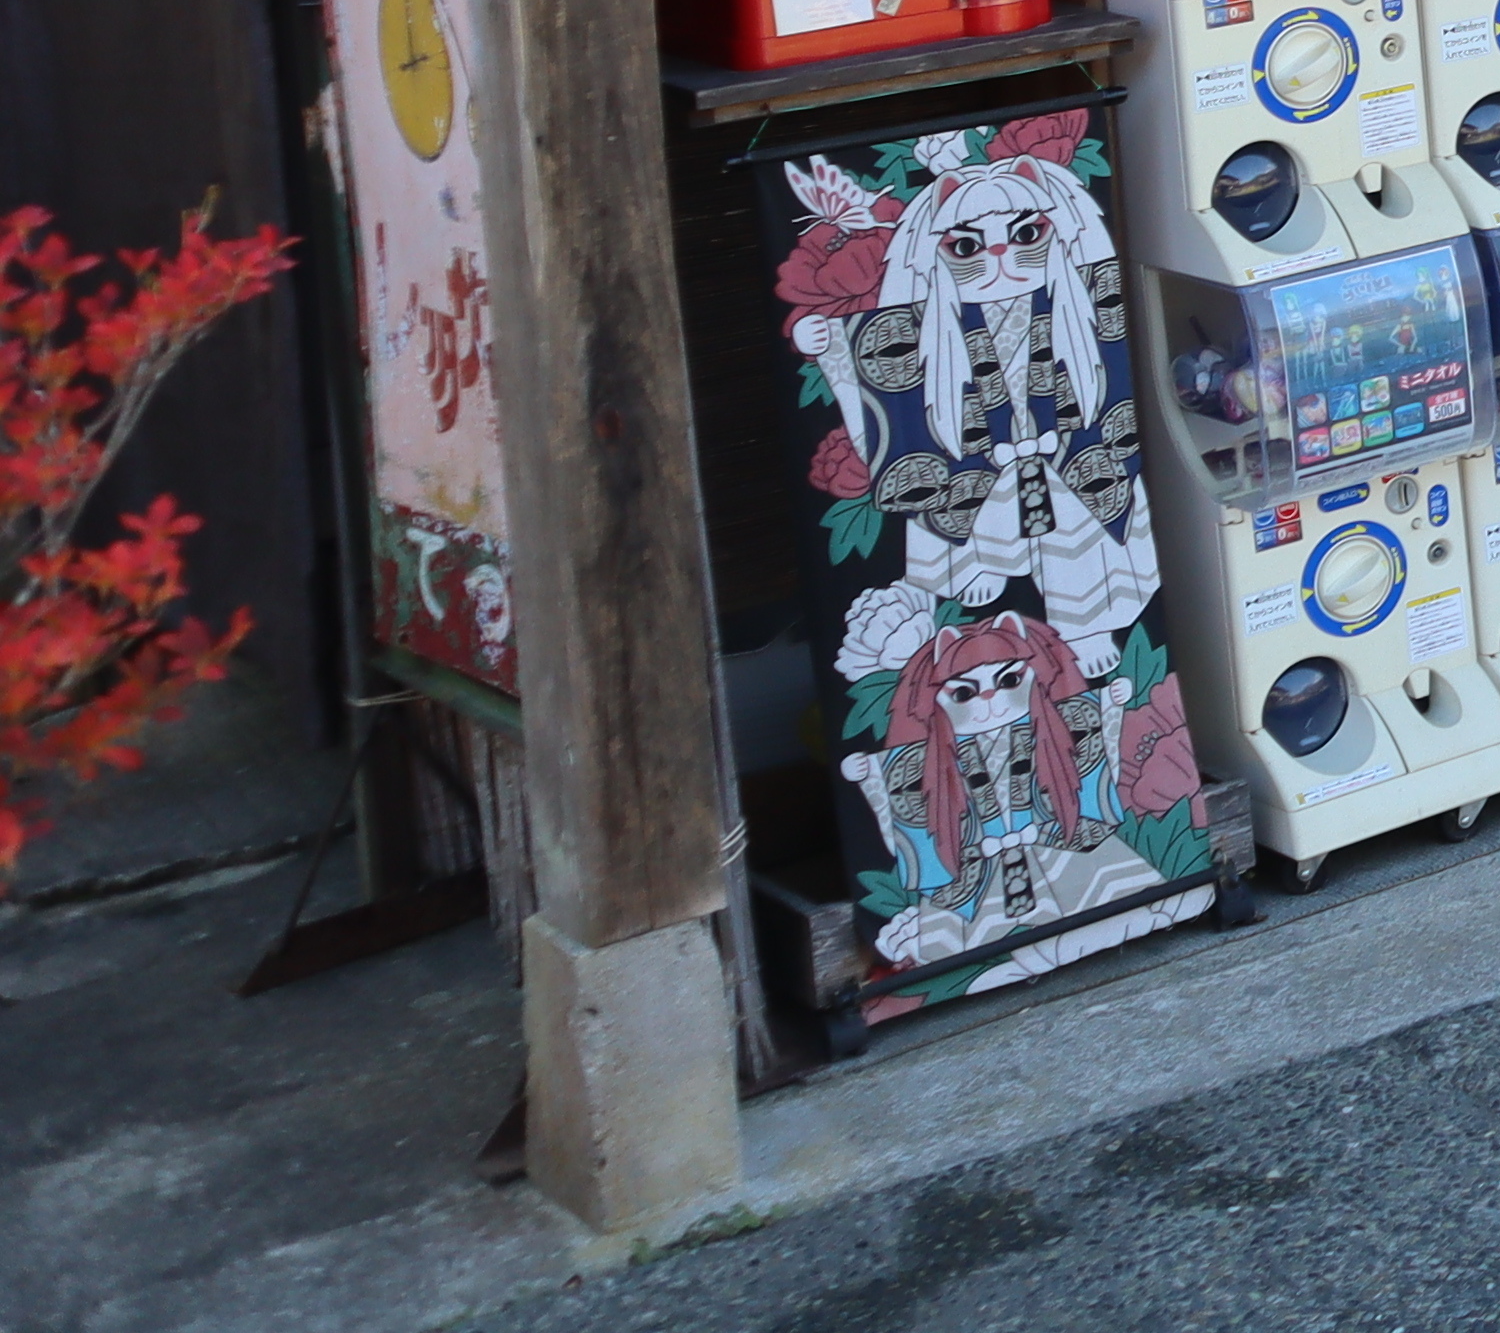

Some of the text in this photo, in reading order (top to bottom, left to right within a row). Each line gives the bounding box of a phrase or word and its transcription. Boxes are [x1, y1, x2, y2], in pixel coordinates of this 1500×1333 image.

[1399, 361, 1464, 391] ミニタオル
